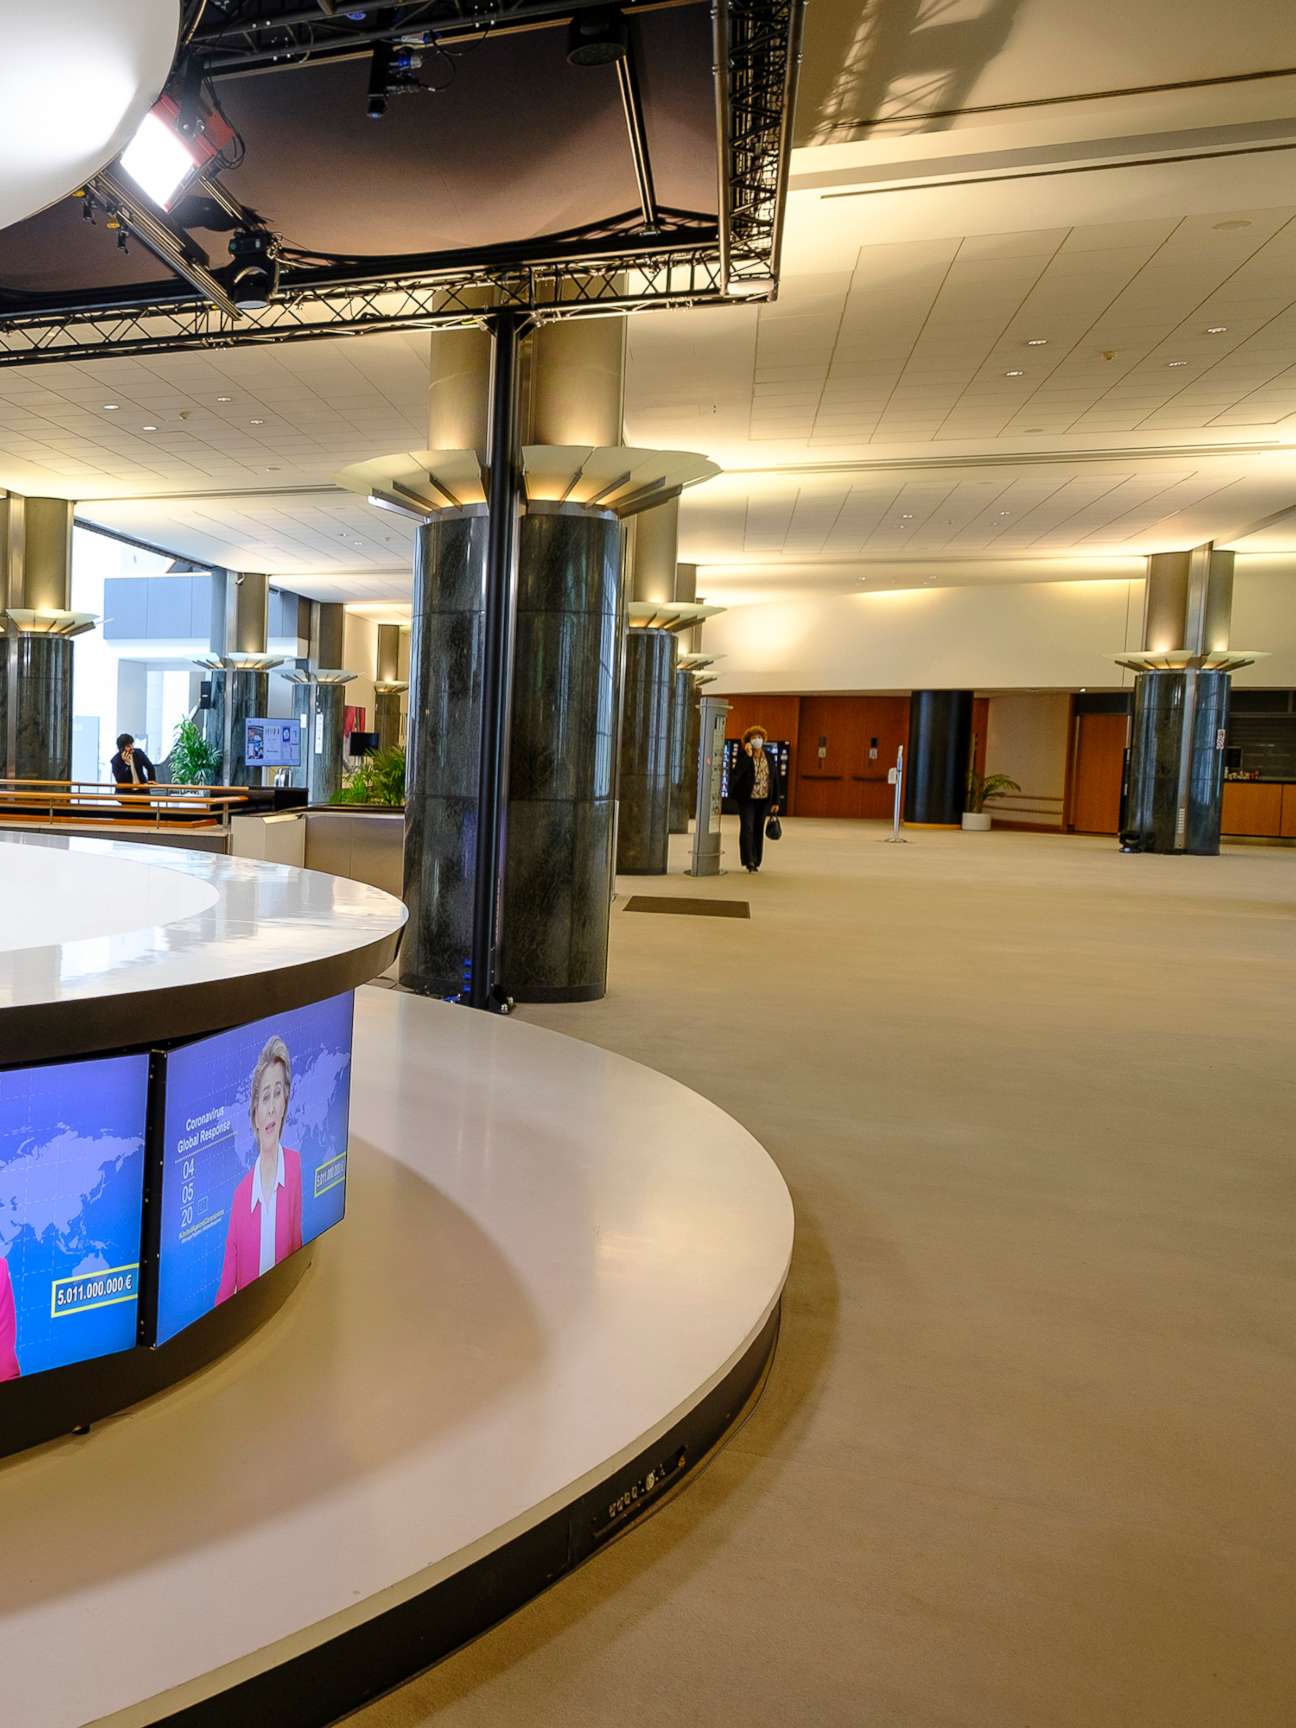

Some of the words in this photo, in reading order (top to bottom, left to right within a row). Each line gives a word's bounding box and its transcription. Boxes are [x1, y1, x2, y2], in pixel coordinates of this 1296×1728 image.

[186, 1106, 224, 1131] Coronavirus
[178, 1133, 198, 1153] Global
[183, 1158, 194, 1180] 04
[182, 1182, 194, 1204] 05
[181, 1206, 192, 1228] 20
[57, 1276, 124, 1305] 5.011.000.000
[126, 1275, 132, 1289] €
